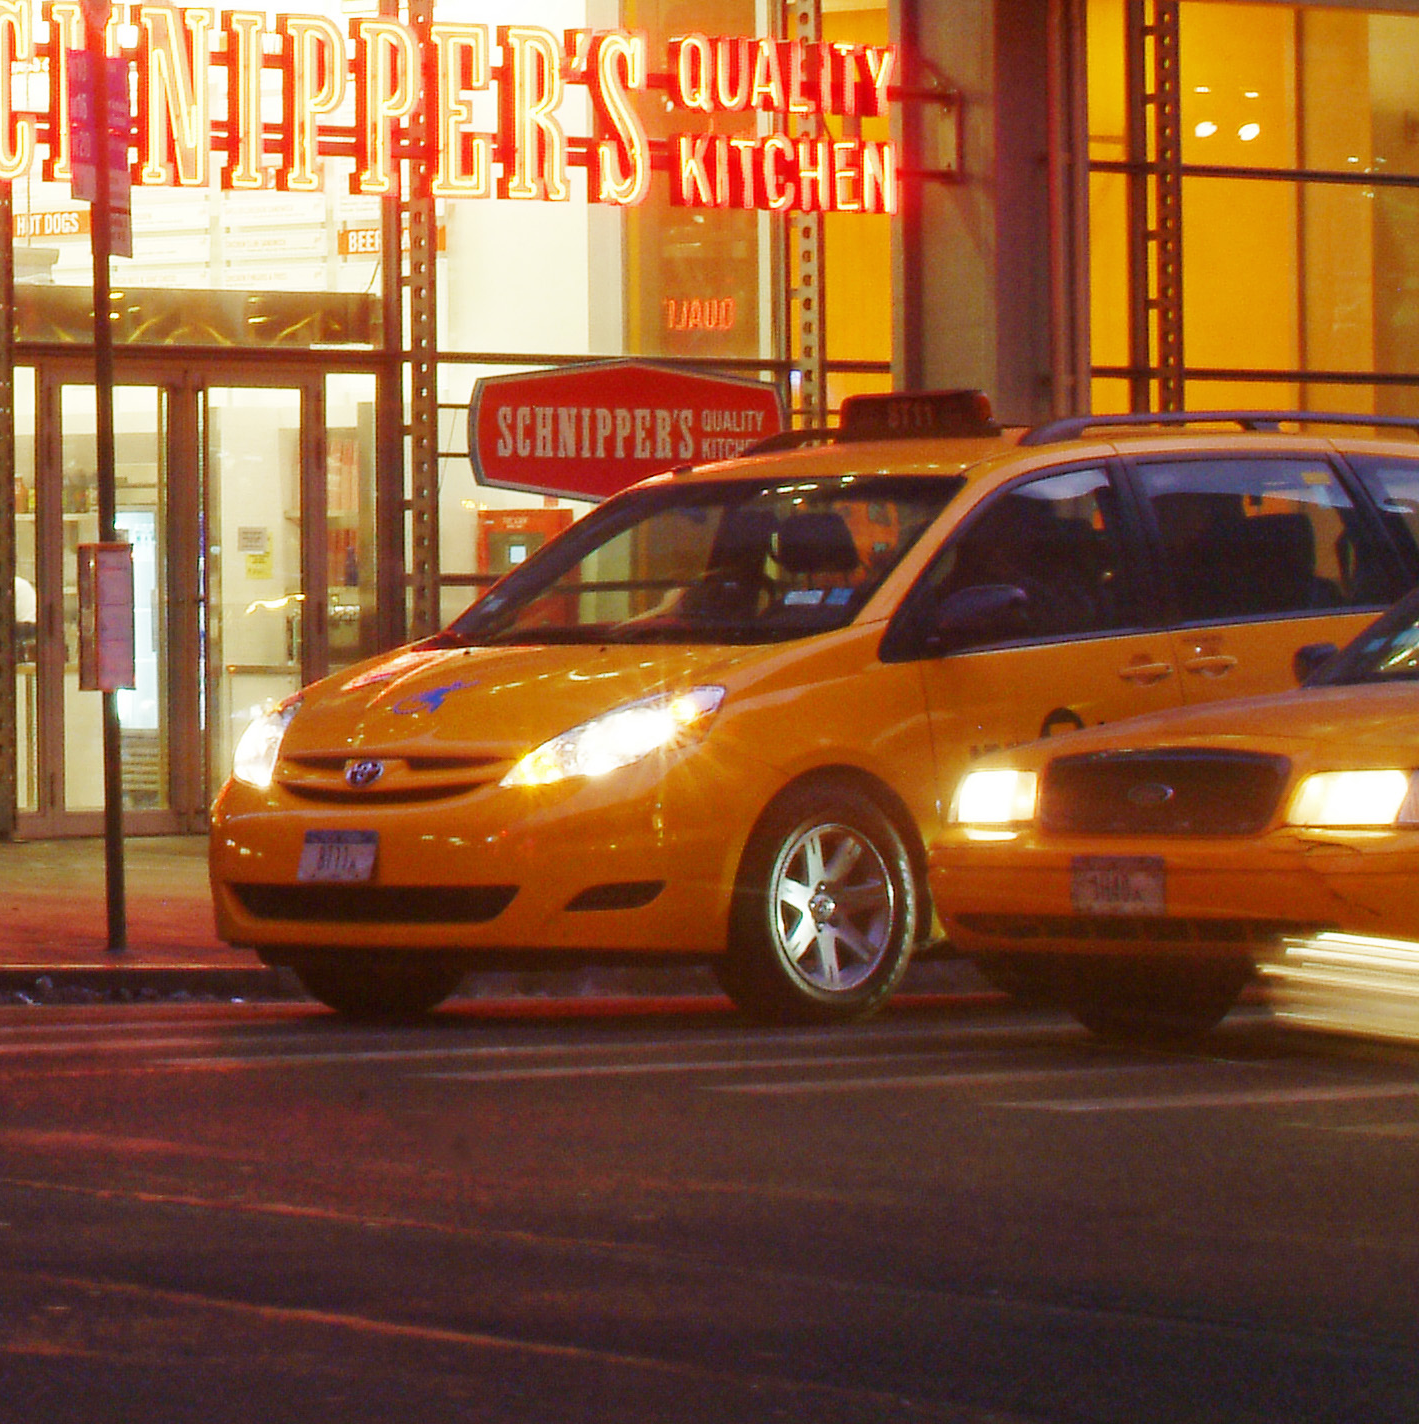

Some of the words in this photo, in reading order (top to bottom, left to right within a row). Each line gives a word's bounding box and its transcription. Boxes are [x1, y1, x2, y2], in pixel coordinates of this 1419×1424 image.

[673, 32, 898, 118] QUALITY
[671, 133, 898, 216] KITCHEN
[16, 214, 44, 237] HOT
[44, 212, 79, 235] DOGS
[497, 406, 695, 460] SCHNIPPER'S
[701, 409, 765, 432] QUALITY
[701, 437, 758, 460] KITCH
